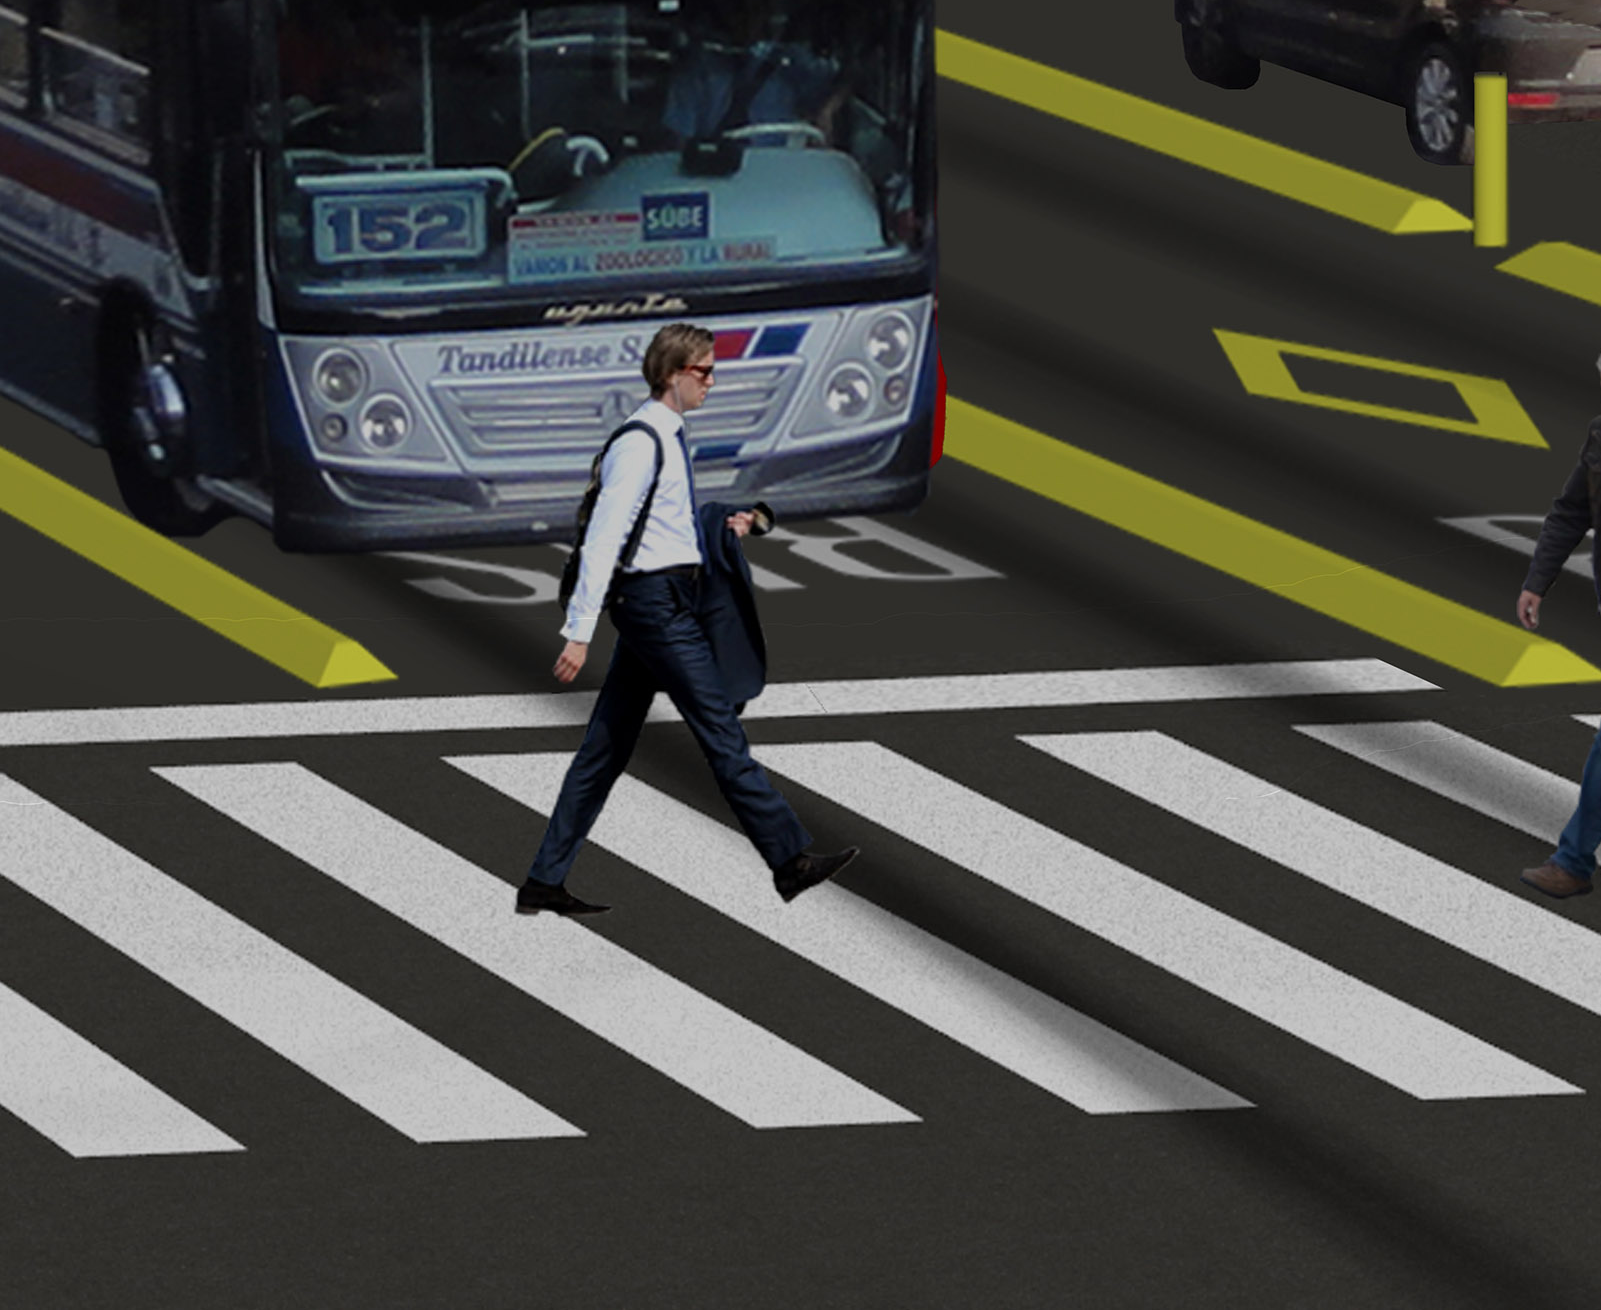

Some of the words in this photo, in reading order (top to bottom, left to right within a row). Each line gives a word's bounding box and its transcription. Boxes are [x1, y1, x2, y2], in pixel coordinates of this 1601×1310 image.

[326, 202, 469, 254] 152
[572, 253, 590, 272] AL
[687, 247, 696, 263] Y
[700, 246, 719, 262] LA
[438, 341, 611, 375] Tandilense
